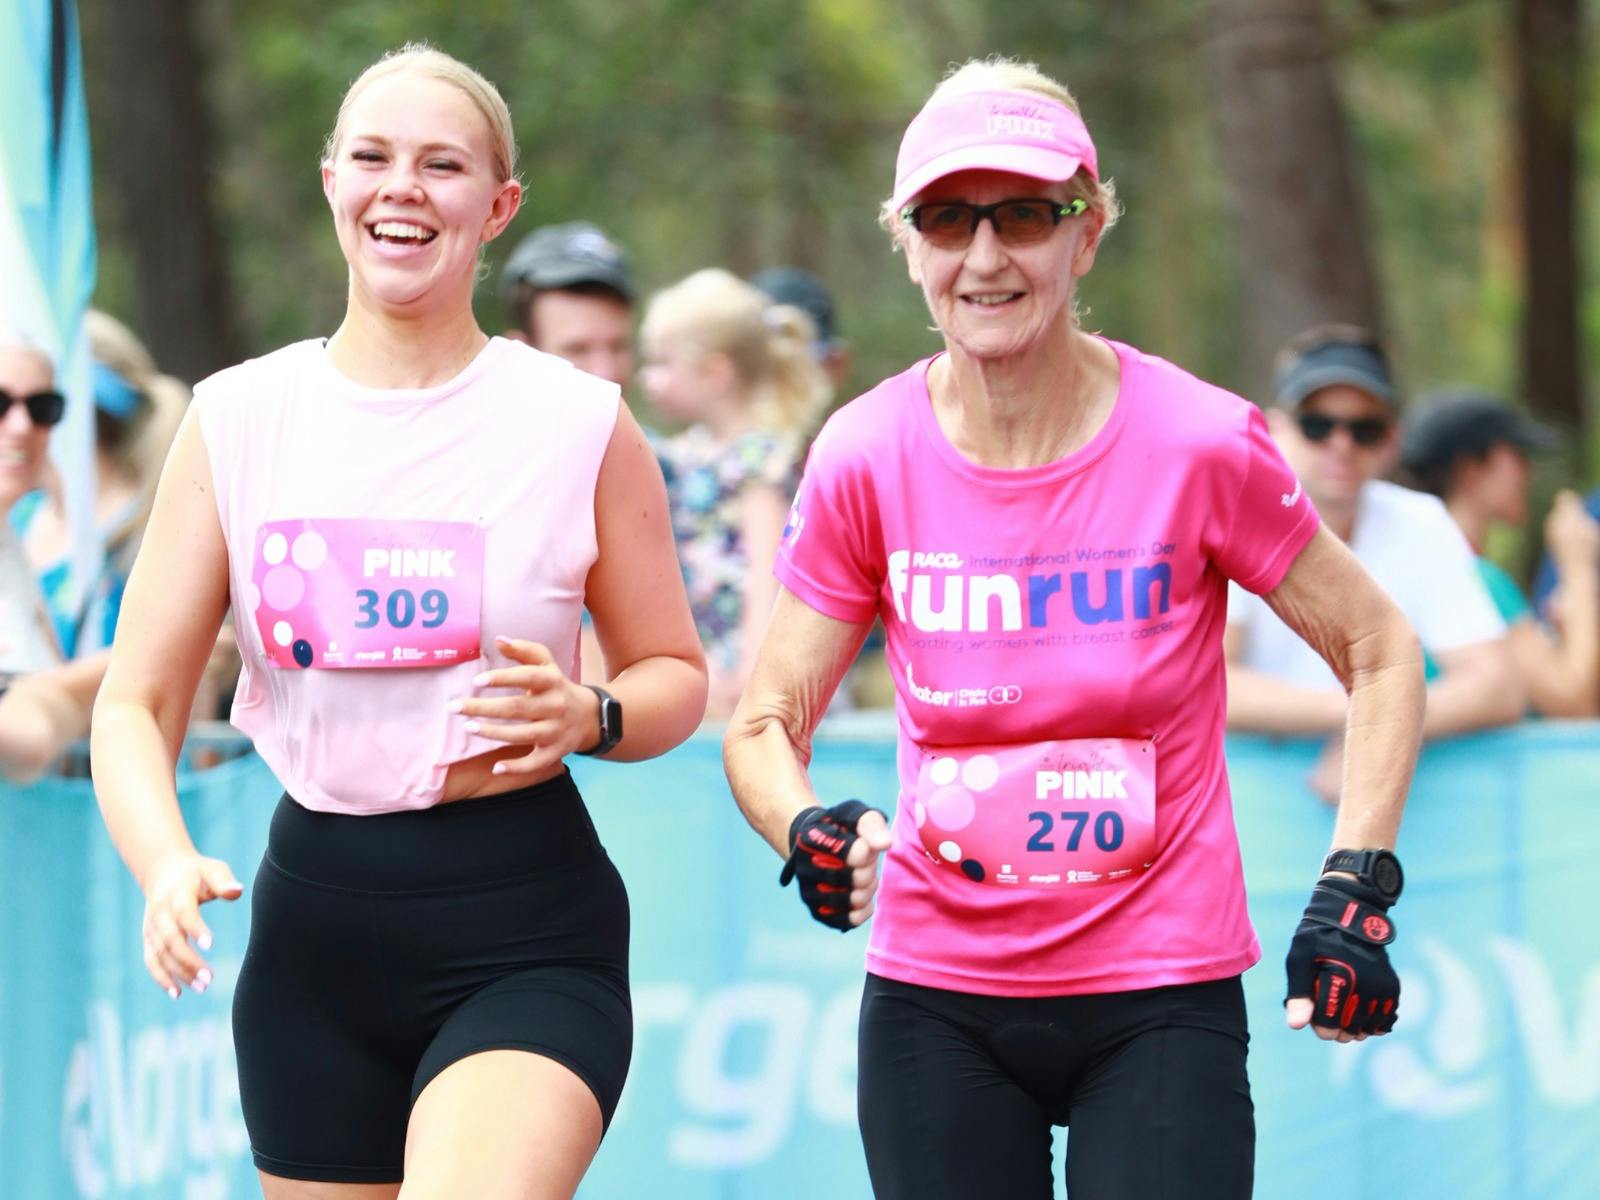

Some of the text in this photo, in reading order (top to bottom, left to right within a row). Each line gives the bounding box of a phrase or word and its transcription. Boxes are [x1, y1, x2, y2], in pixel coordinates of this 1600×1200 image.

[363, 549, 456, 578] PINK
[969, 549, 1070, 568] International
[1076, 547, 1146, 562] Women's
[354, 588, 450, 629] 309
[969, 638, 1029, 650] women
[1034, 632, 1068, 647] with
[1072, 630, 1125, 645] breast
[1130, 620, 1174, 641] cancer
[1035, 770, 1129, 800] PINK
[1026, 810, 1125, 853] 270
